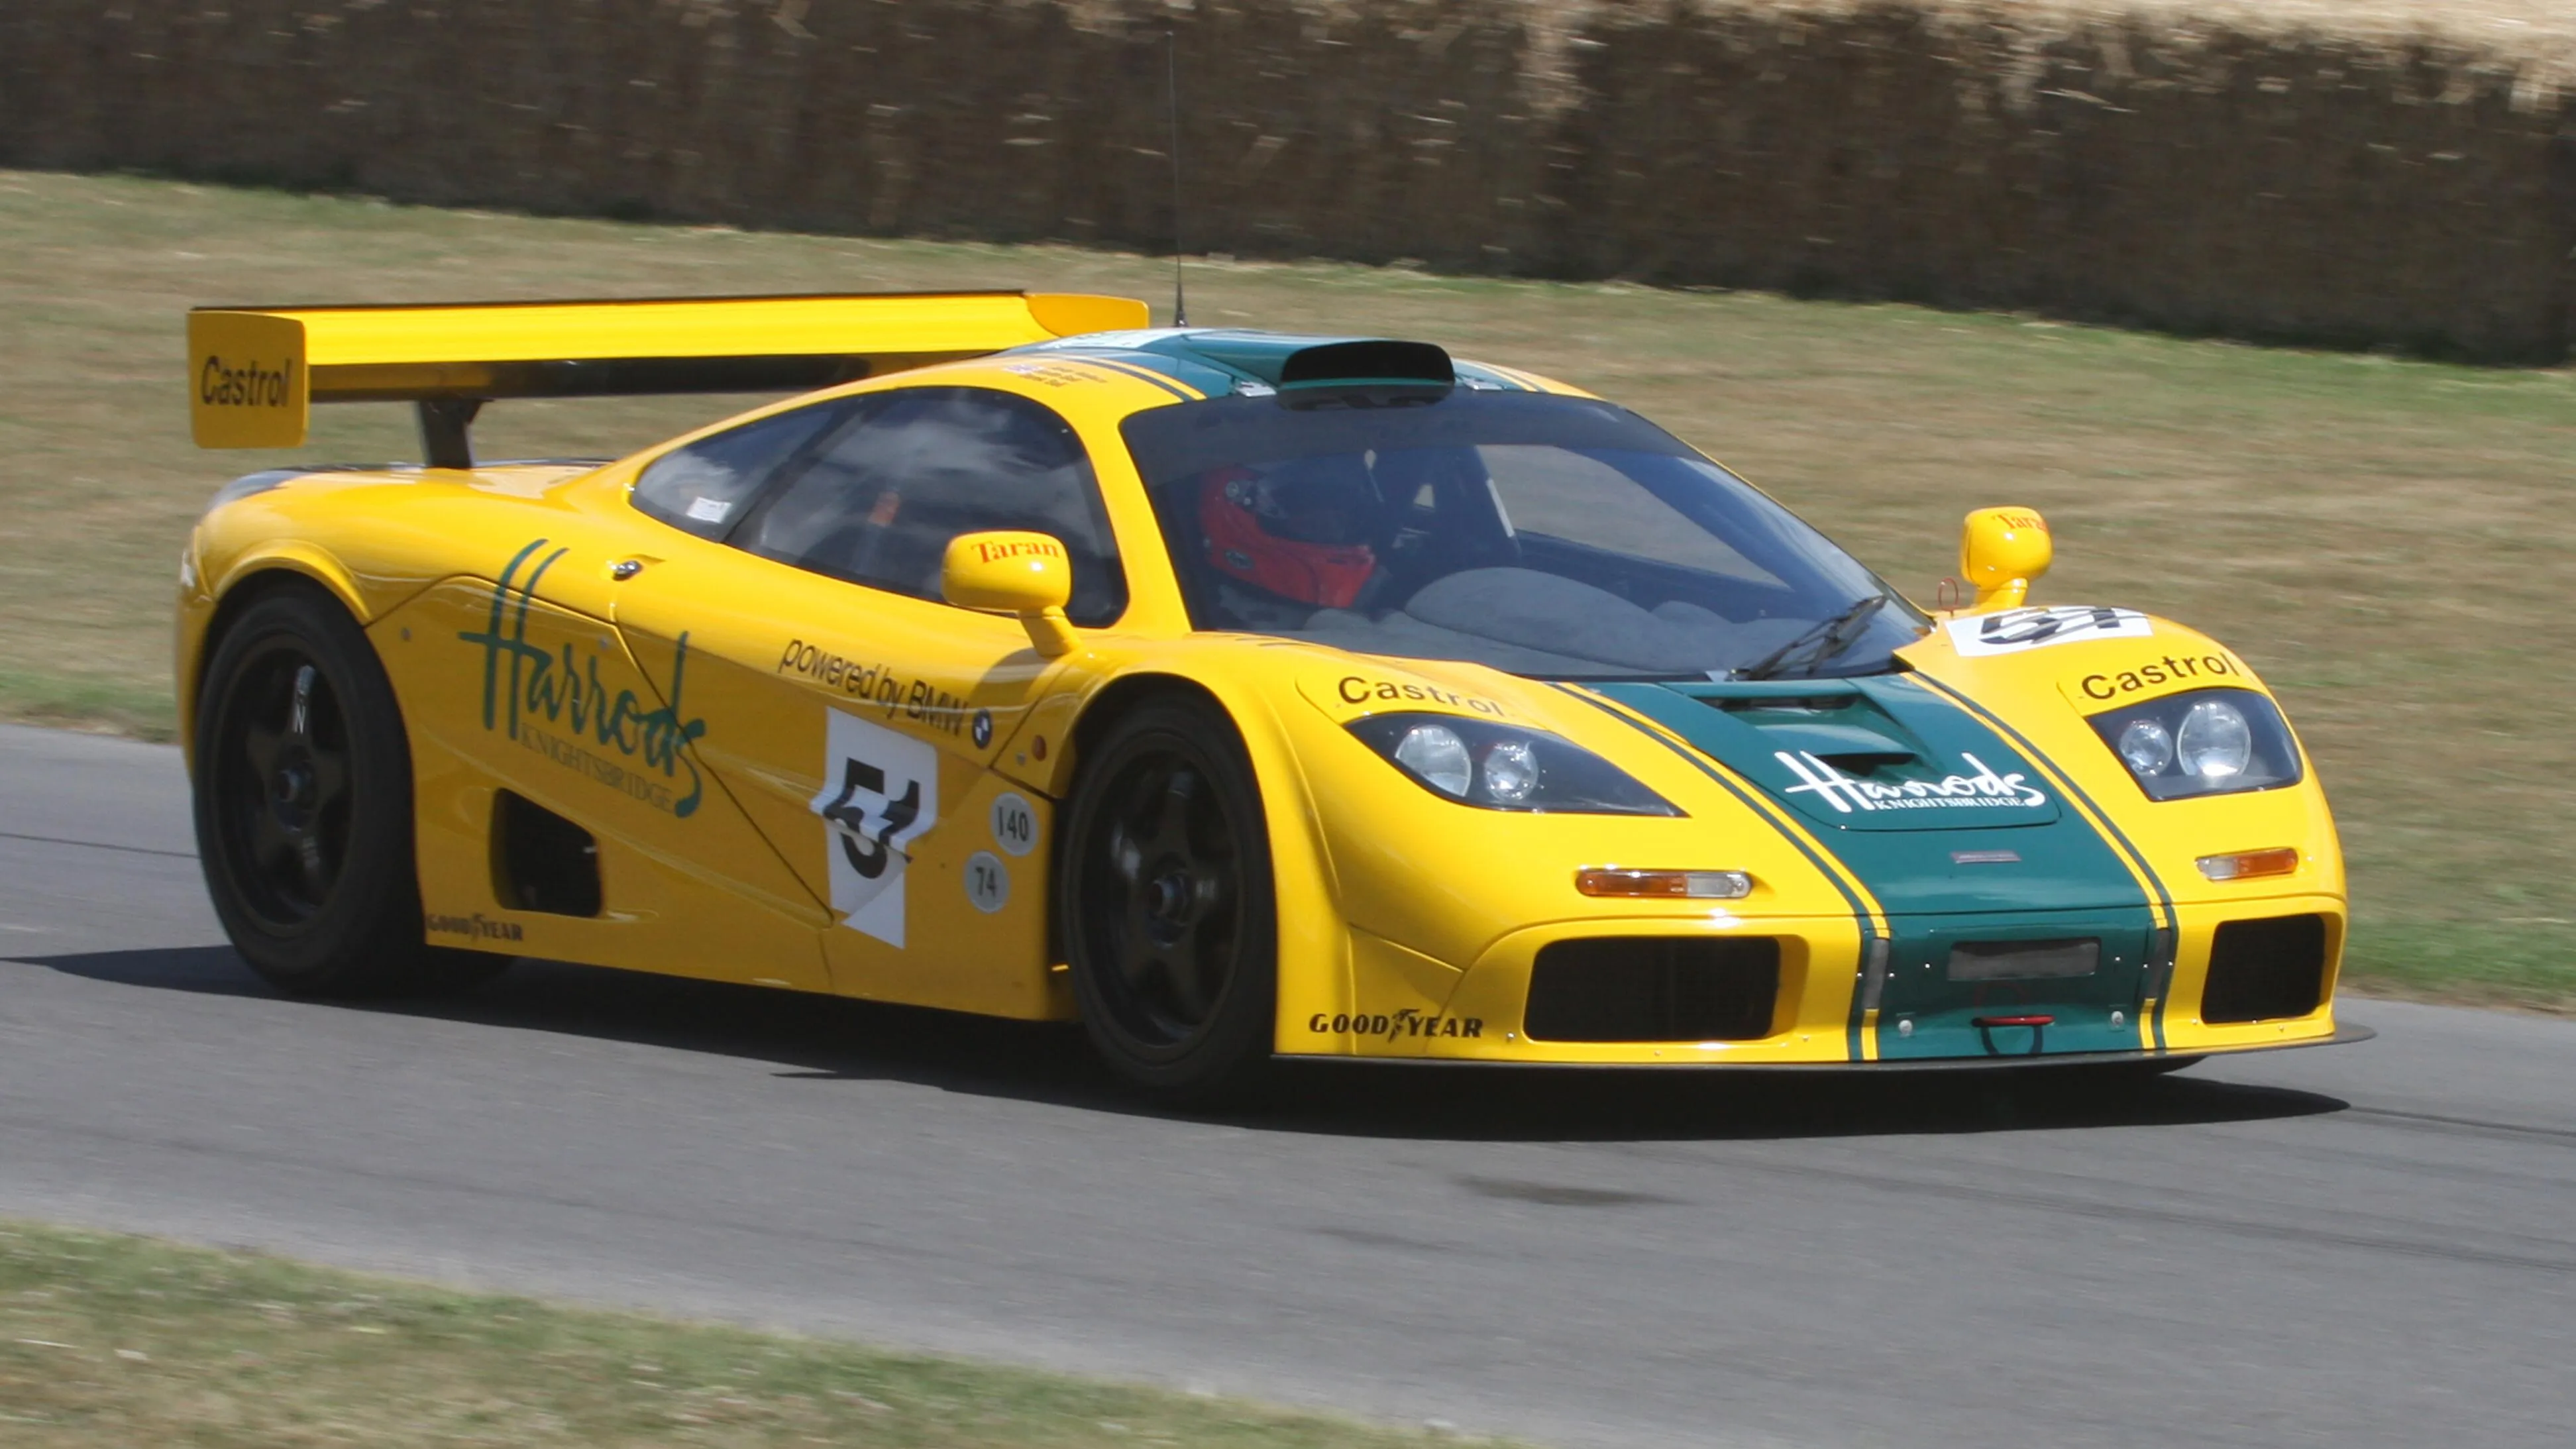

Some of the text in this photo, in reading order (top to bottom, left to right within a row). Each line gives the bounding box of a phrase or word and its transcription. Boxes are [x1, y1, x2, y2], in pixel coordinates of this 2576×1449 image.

[201, 355, 292, 407] Castrol
[1991, 513, 2049, 531] Tara
[970, 541, 1059, 563] Taran
[1978, 607, 2121, 645] 51
[458, 538, 706, 818] Harrods
[778, 639, 969, 735] powered by BMW
[1338, 676, 1505, 717] Castrol
[2082, 652, 2240, 700] Castrol
[1774, 751, 2045, 812] Harrods
[823, 757, 920, 879] 51
[998, 807, 1029, 842] 140
[975, 866, 996, 897] 74
[1309, 1009, 1483, 1044] GOODYEAR
